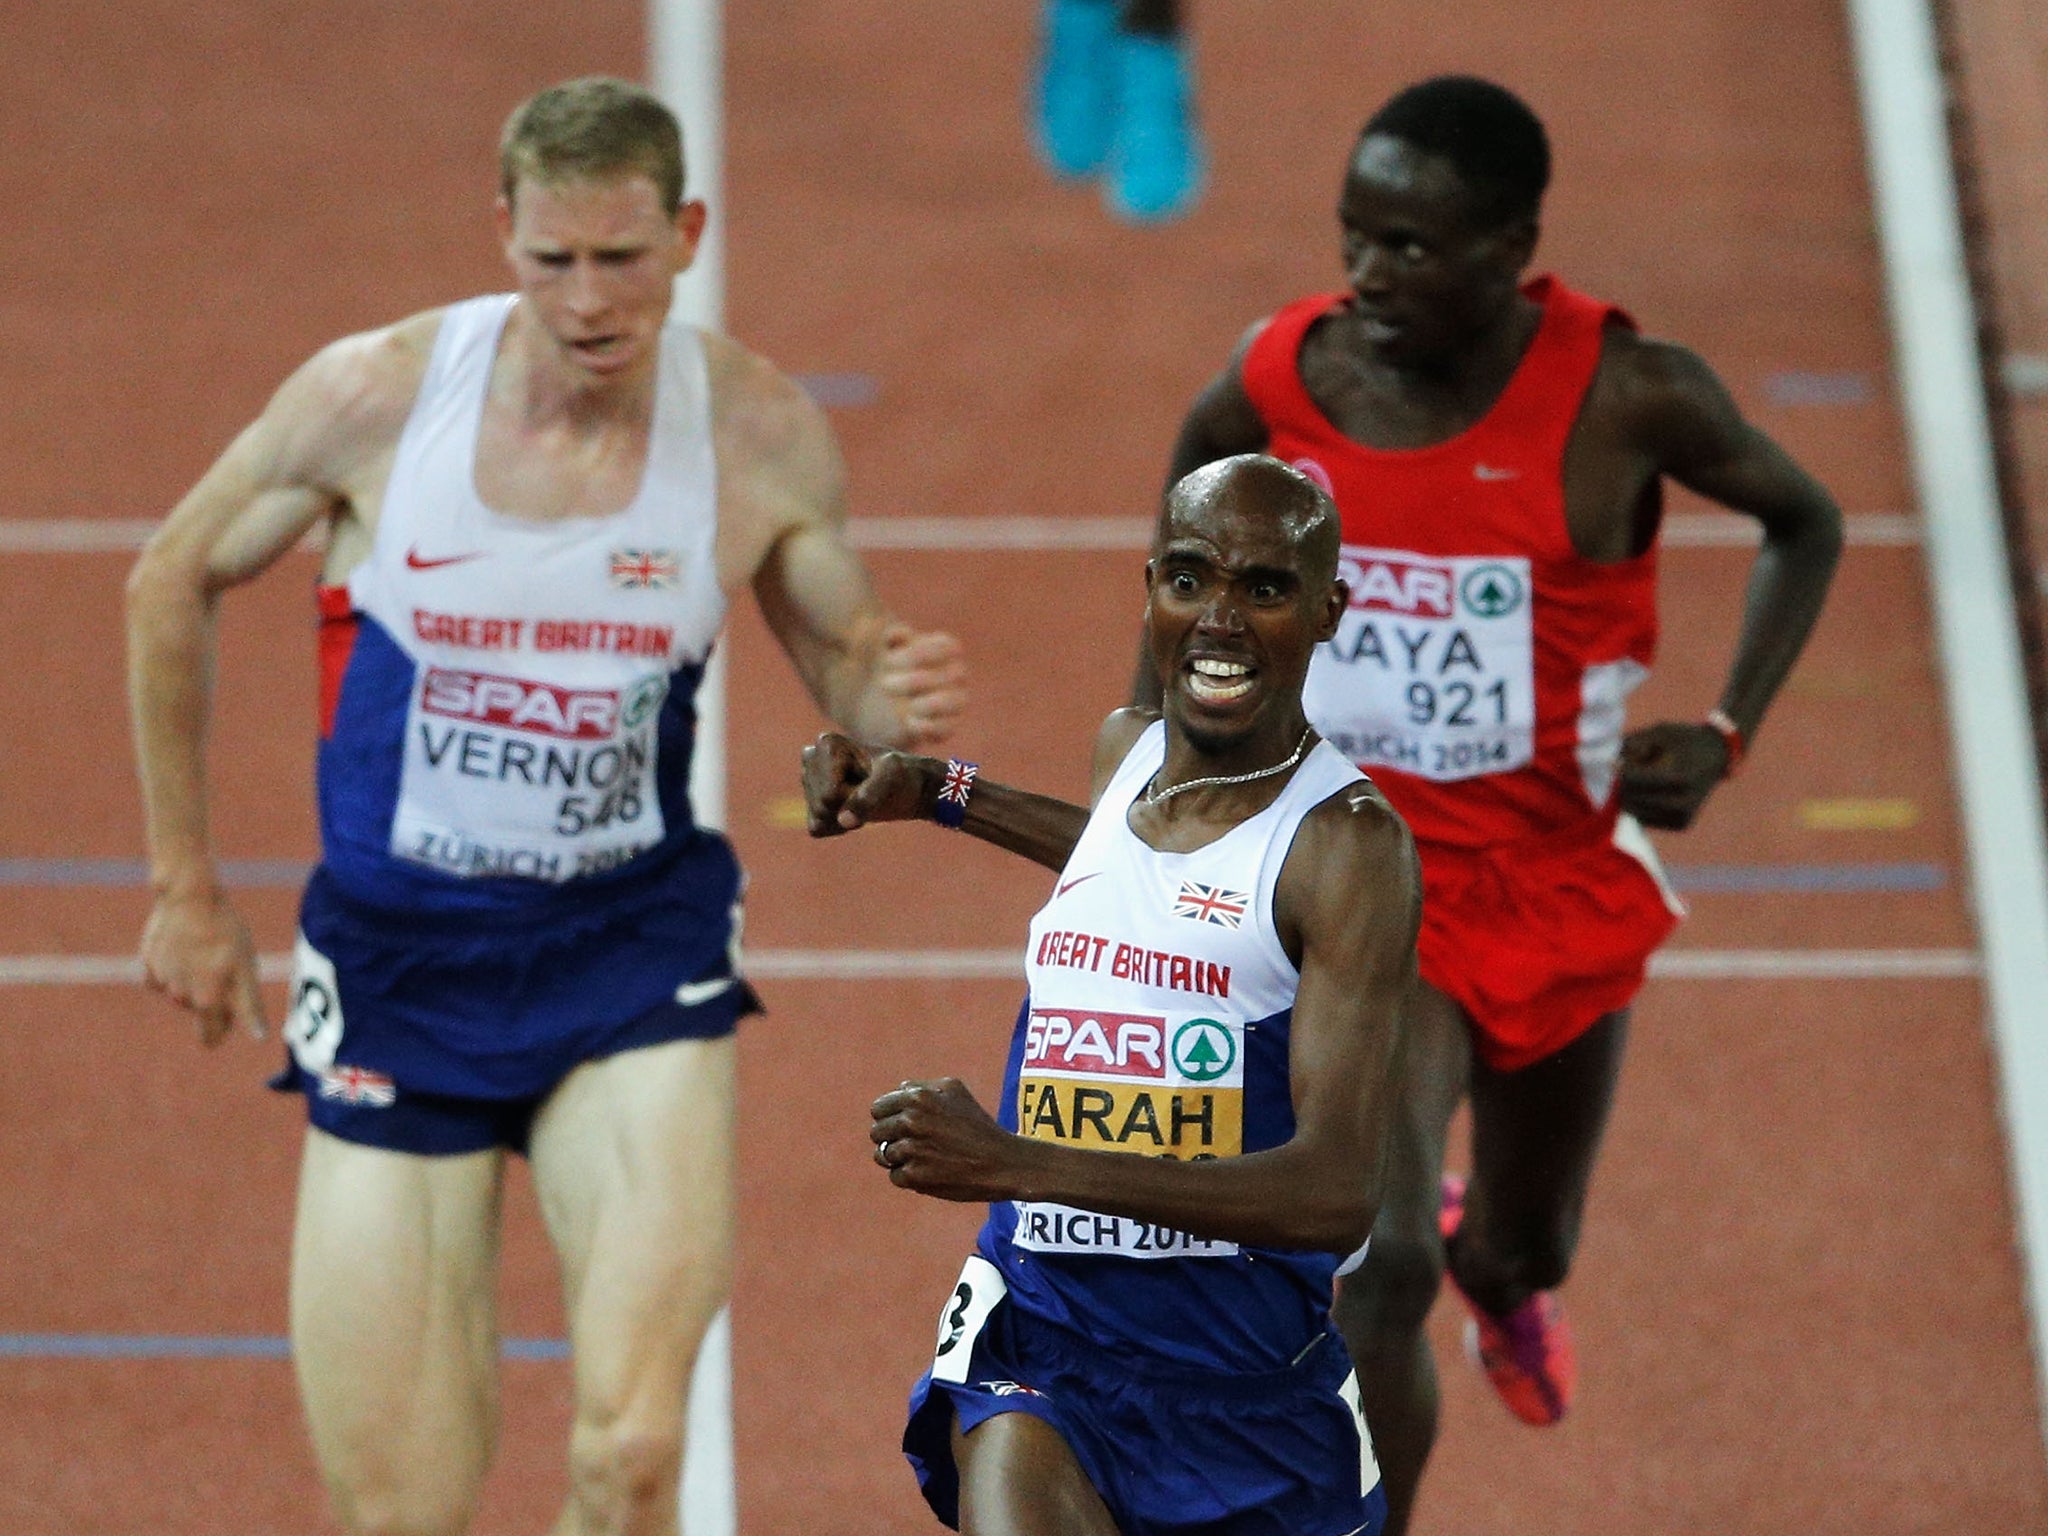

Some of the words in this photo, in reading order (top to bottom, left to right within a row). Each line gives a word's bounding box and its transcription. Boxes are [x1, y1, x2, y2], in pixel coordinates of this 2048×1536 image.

[413, 608, 522, 650] GREAT
[535, 620, 672, 658] BRITAIN
[426, 672, 615, 736] SPAR
[1406, 678, 1508, 725] 921
[420, 720, 647, 788] VERNON
[1111, 942, 1231, 998] BRITAIN
[1027, 1014, 1163, 1071] SPAR
[1023, 1084, 1214, 1146] FARAH
